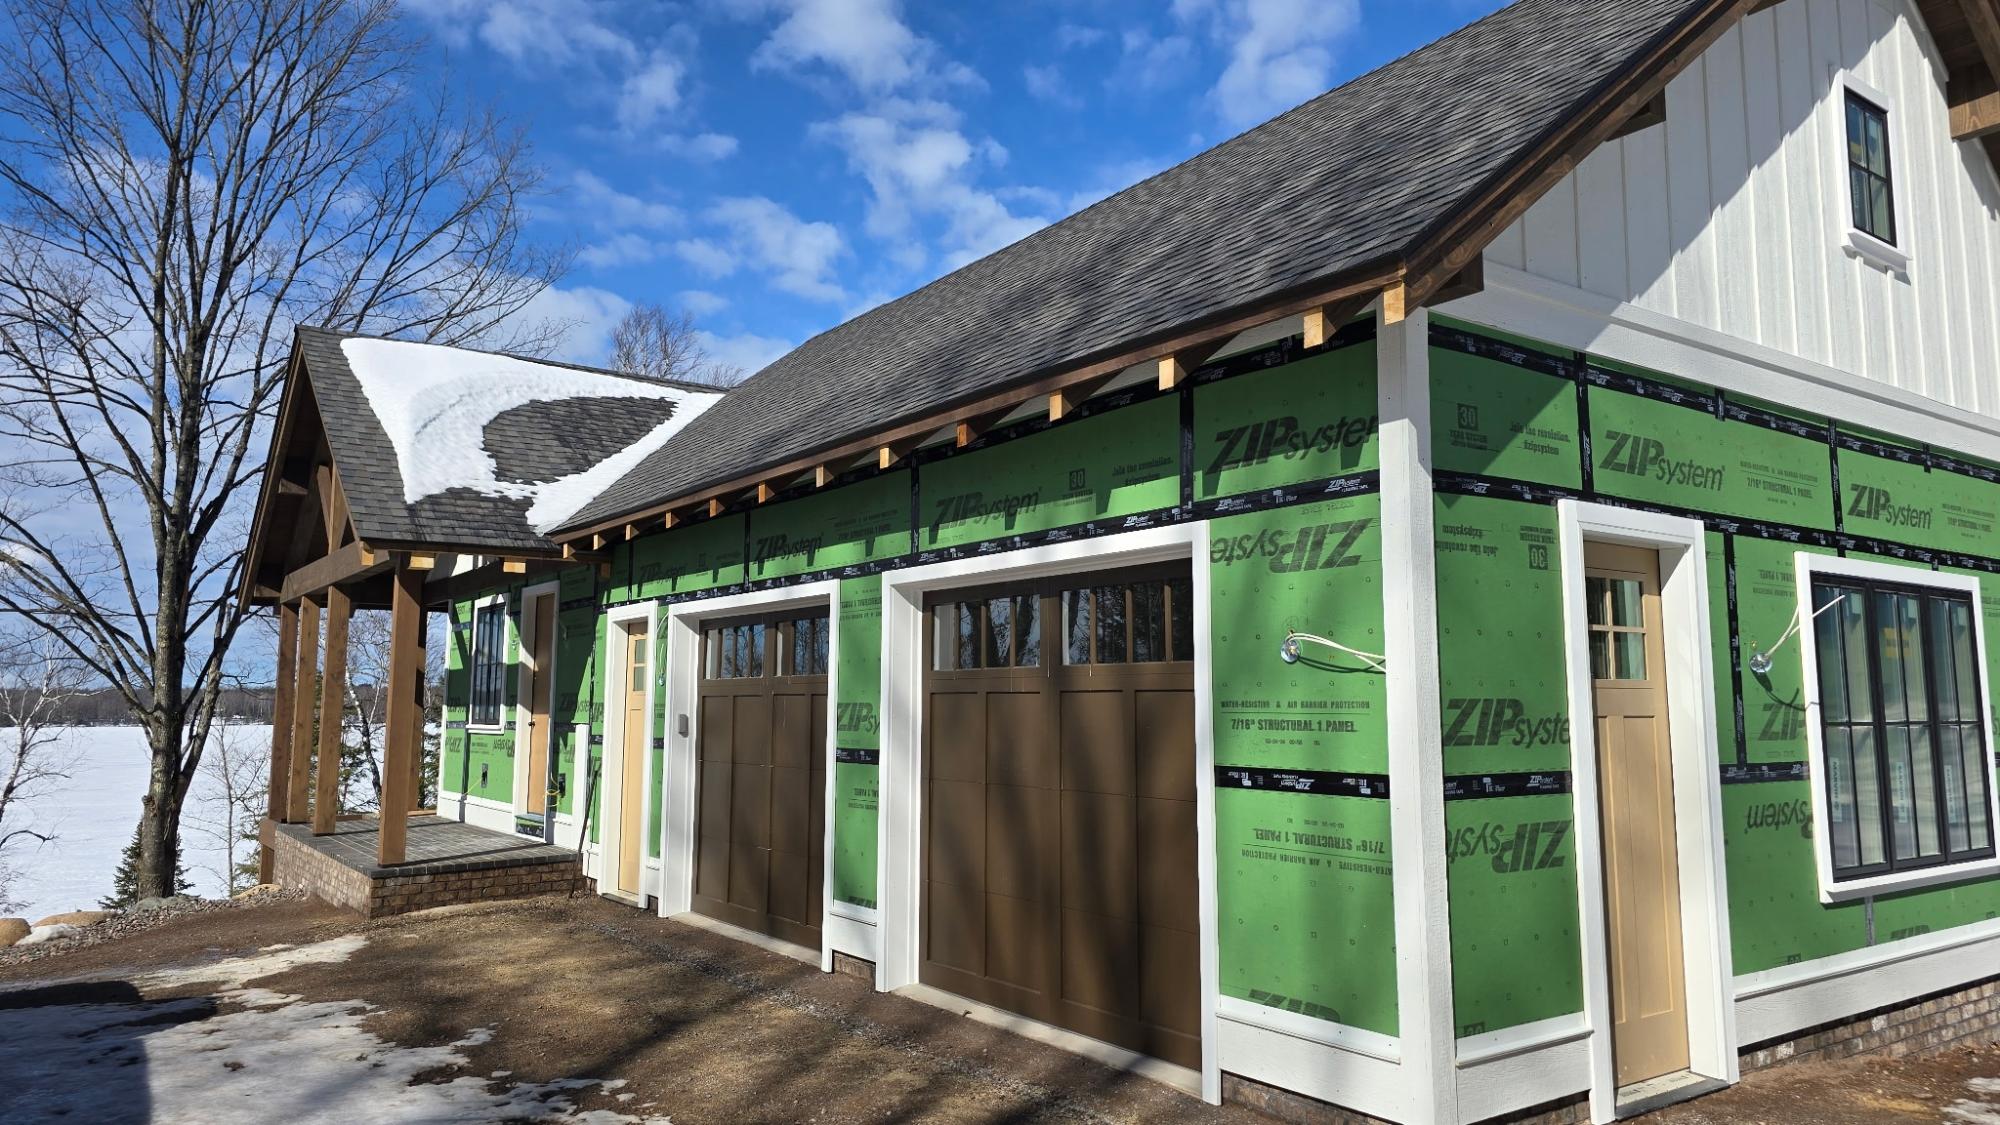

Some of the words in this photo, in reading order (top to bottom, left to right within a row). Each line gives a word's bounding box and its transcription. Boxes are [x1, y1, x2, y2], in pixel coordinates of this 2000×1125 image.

[1459, 405, 1477, 428] 30
[1600, 430, 1723, 491] ZIPsystem
[1069, 469, 1086, 489] 30
[933, 489, 1041, 528] ZIPsystem
[1847, 483, 1932, 530] ZIPsystem
[756, 533, 821, 562] ZIPsystem
[1210, 518, 1374, 574] ZIPsyste
[1529, 545, 1547, 568] 30
[1276, 700, 1281, 709] &
[1287, 701, 1298, 709] AIR
[1300, 701, 1328, 709] BARRIER
[1330, 701, 1370, 709] PROTECTION
[1231, 719, 1255, 731] 7/16"
[1257, 719, 1315, 732] STRUCTURAL
[1317, 721, 1323, 732] 1
[1325, 720, 1358, 733] PANEL
[1444, 698, 1570, 748] ZIPsyste
[1254, 828, 1281, 842] PANEL
[1284, 832, 1290, 842] 1
[1293, 832, 1353, 850] STRUCTURAL
[1241, 848, 1277, 861] PROTECTION
[1356, 839, 1385, 854] 7/16"
[1280, 854, 1306, 864] BARRIER
[1309, 857, 1320, 866] AIR
[1326, 859, 1332, 868] &
[1339, 860, 1392, 876] ATER-RESISTIVE
